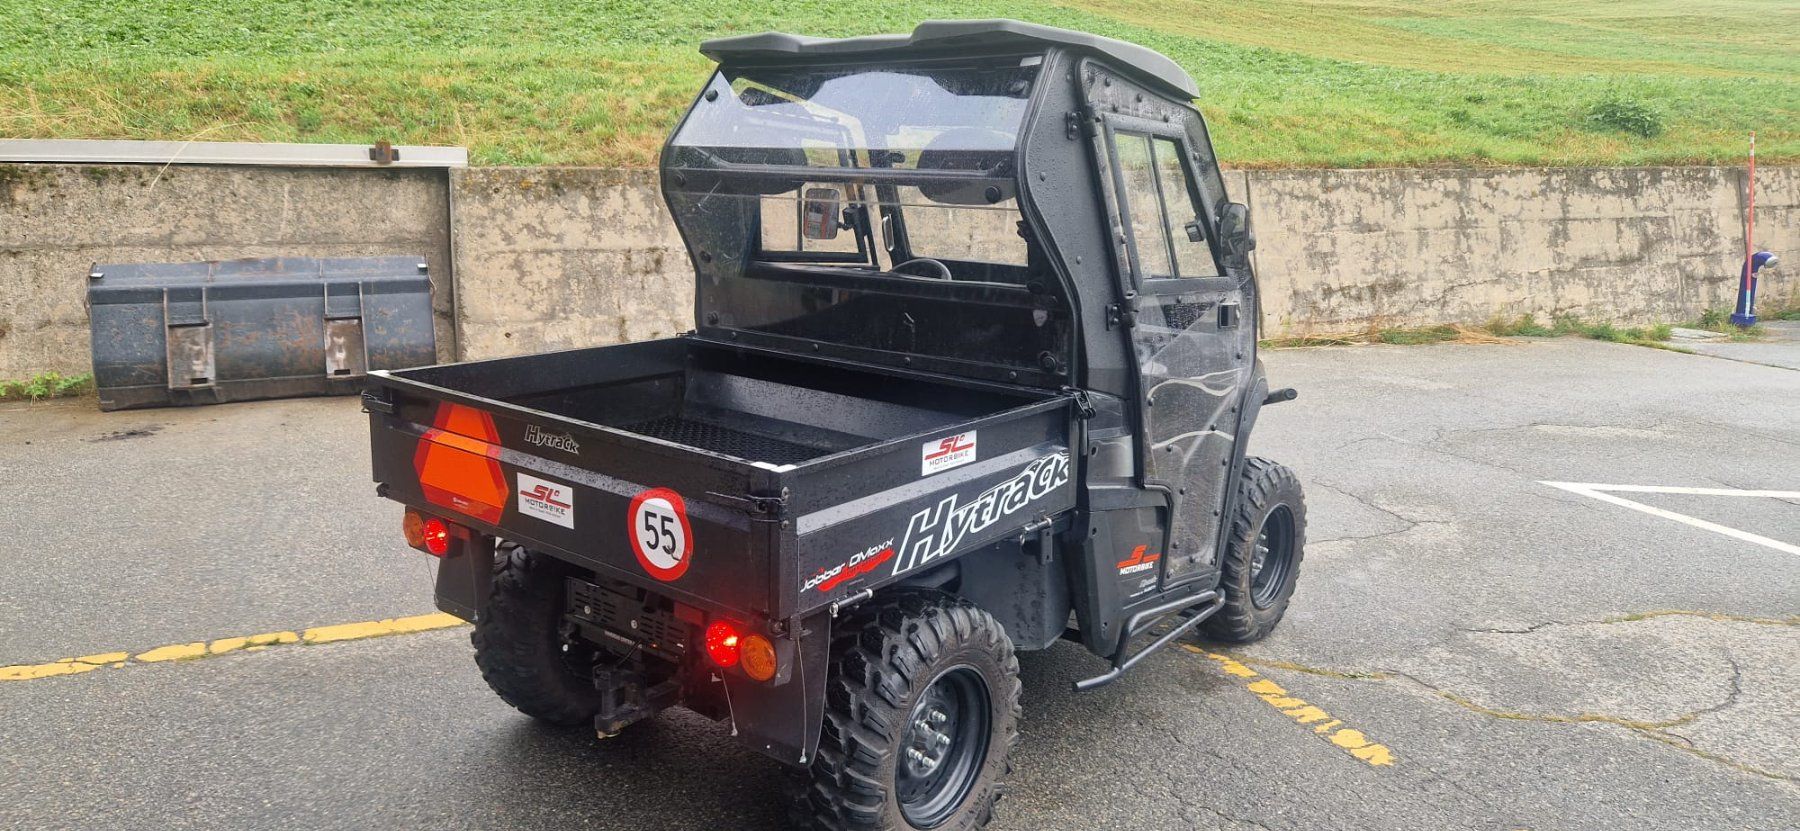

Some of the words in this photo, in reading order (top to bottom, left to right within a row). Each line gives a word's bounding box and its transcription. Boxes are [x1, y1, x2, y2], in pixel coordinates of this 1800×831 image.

[929, 450, 969, 467] MOTORBIKE
[525, 498, 566, 515] MOTORBIKE
[644, 510, 676, 554] 55
[800, 562, 845, 593] Jobbar
[849, 537, 895, 567] DMaxx
